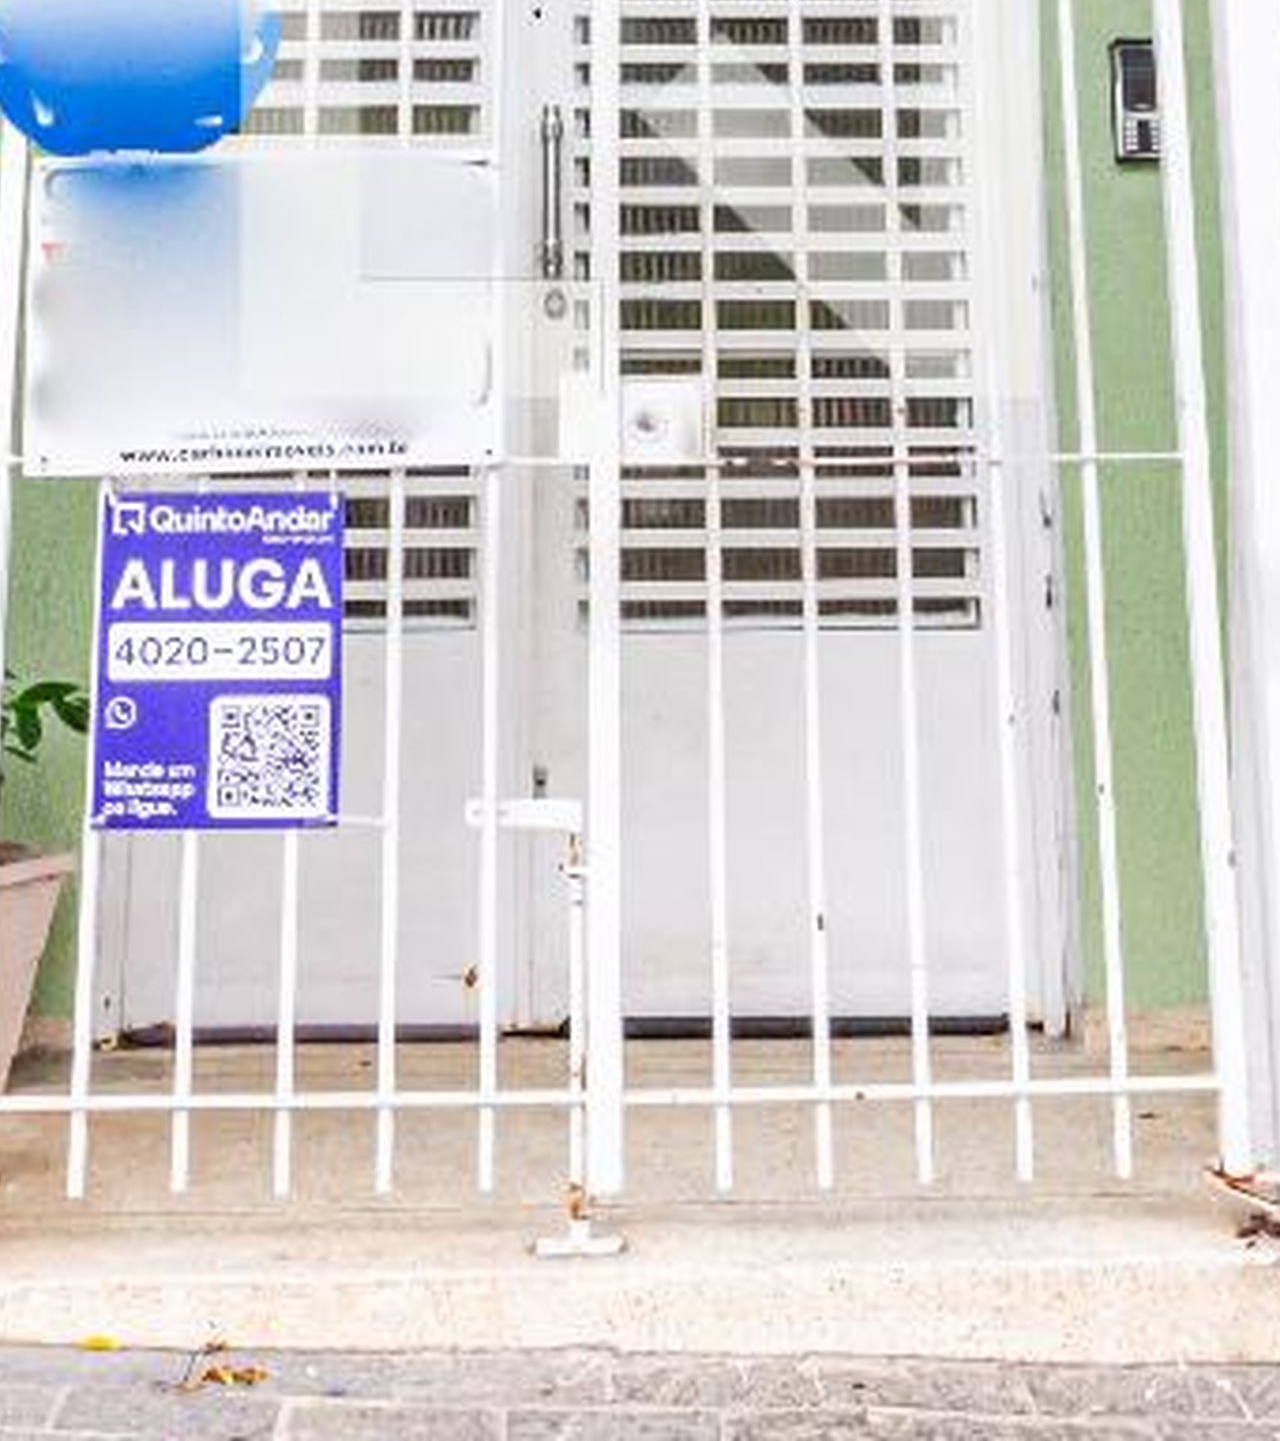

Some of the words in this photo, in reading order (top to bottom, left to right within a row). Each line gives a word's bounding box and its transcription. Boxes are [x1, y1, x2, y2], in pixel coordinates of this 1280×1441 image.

[149, 505, 334, 535] QuintoAndar
[110, 557, 333, 609] ALUGA
[115, 636, 326, 666] 4020-2507
